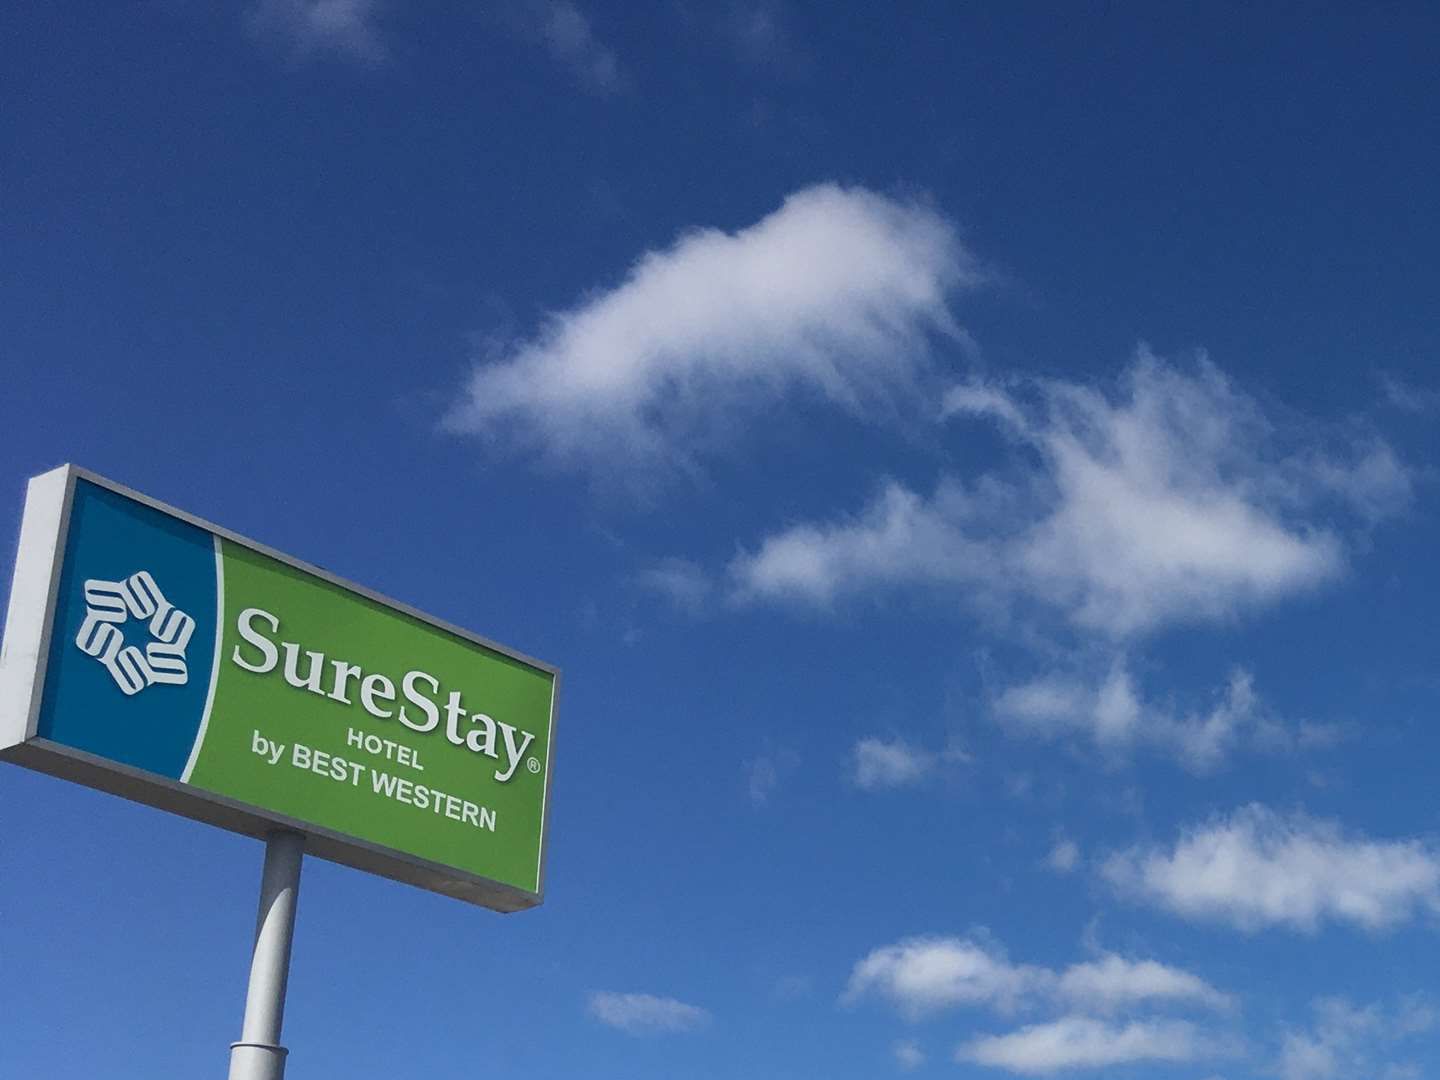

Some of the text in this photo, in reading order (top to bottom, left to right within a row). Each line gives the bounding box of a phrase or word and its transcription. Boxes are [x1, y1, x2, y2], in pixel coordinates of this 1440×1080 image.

[232, 607, 536, 782] SureStay
[251, 729, 497, 833] by BEST WESTERN
[347, 727, 424, 771] HOTEL
